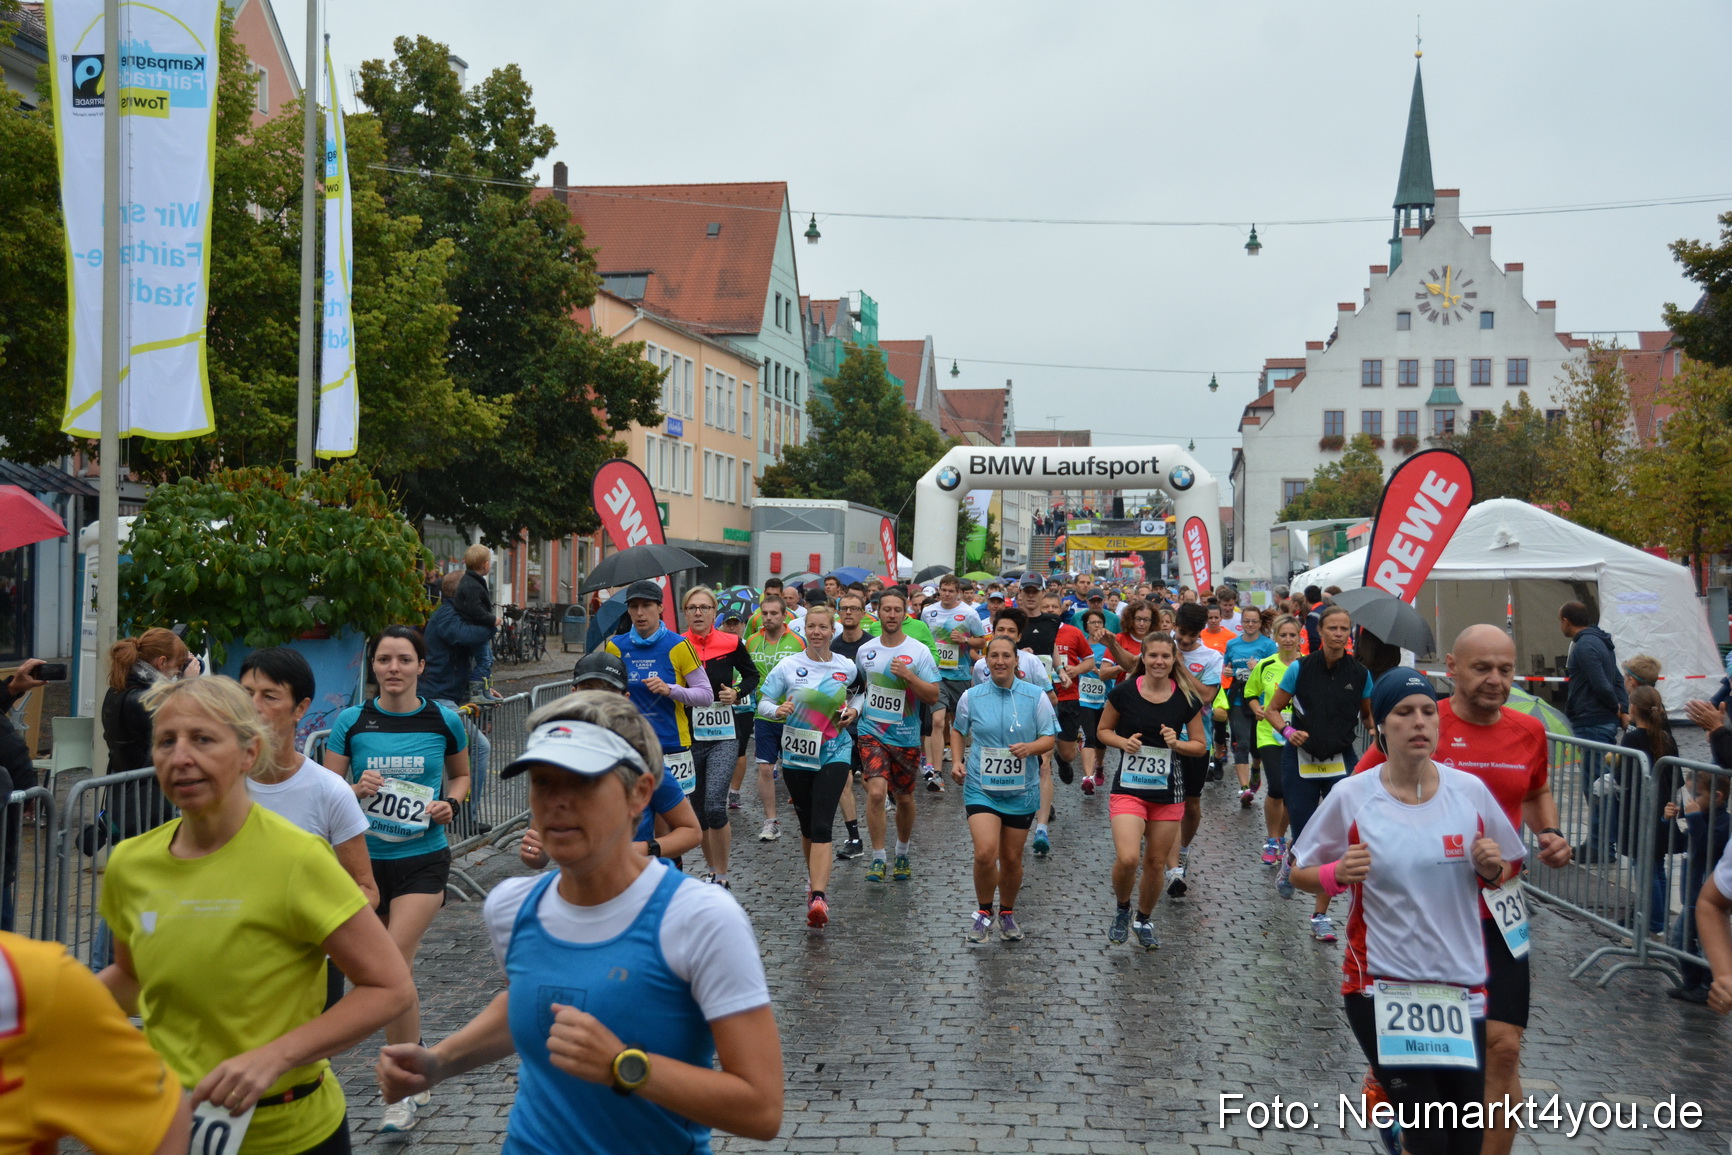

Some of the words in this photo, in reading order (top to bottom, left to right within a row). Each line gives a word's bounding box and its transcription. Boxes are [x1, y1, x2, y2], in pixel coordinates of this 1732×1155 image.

[969, 455, 1036, 476] BMW
[1042, 455, 1160, 480] Laufsport
[1106, 539, 1129, 548] ZIEL
[1373, 470, 1459, 600] REWE
[1187, 525, 1208, 586] REWE
[1081, 683, 1104, 695] 2329
[870, 693, 902, 712] 3059
[697, 710, 731, 726] 2600
[784, 736, 817, 756] 2430
[367, 756, 425, 769] HUBER
[984, 757, 1023, 775] 2739
[1126, 755, 1166, 775] 2733
[1458, 760, 1490, 768] Amberger
[990, 777, 1015, 785] Melanie
[1131, 775, 1158, 785] Melanie
[367, 791, 426, 823] 2062
[371, 819, 412, 836] Christina
[1445, 848, 1464, 856] DKMS
[1385, 1001, 1464, 1035] 2800
[1405, 1039, 1450, 1053] Marina
